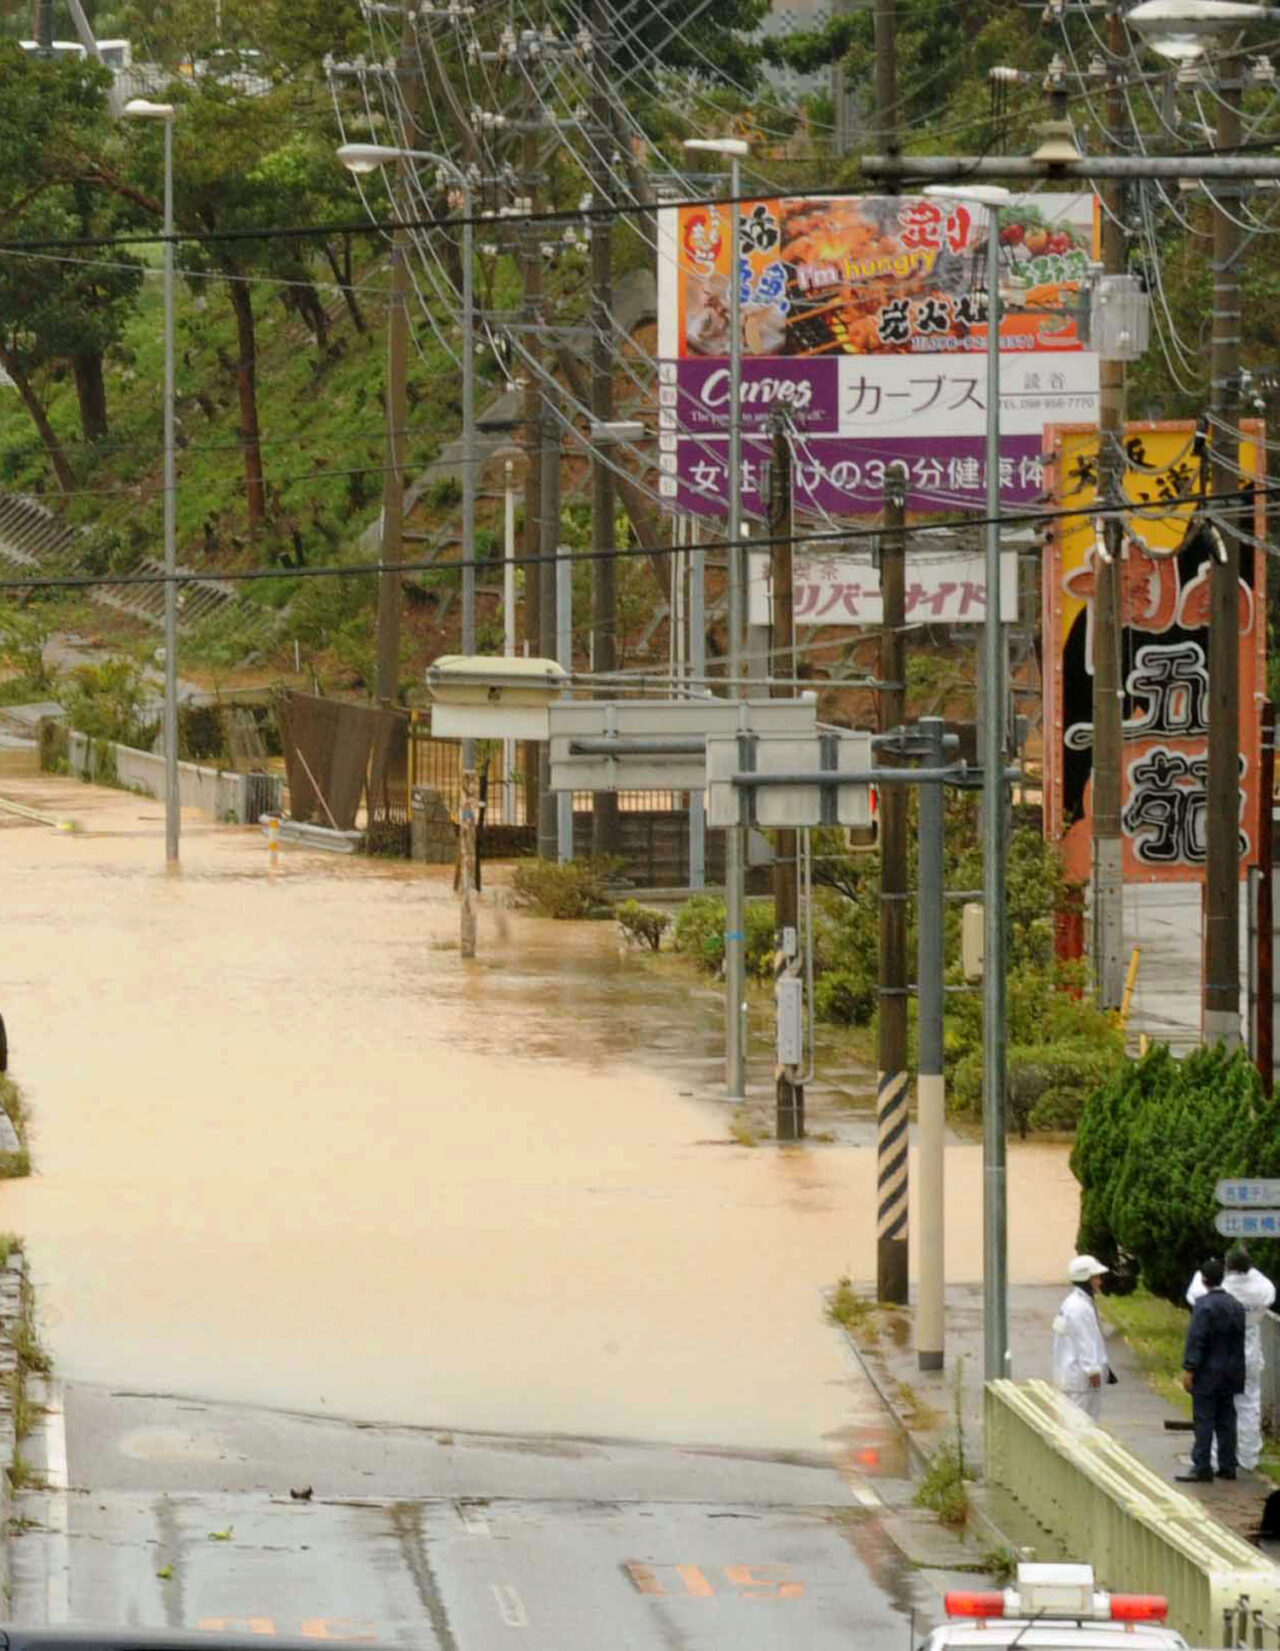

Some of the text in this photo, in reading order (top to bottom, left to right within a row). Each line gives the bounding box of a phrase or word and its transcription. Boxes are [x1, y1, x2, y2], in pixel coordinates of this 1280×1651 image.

[845, 249, 936, 281] hungry
[847, 374, 986, 415] カーブス
